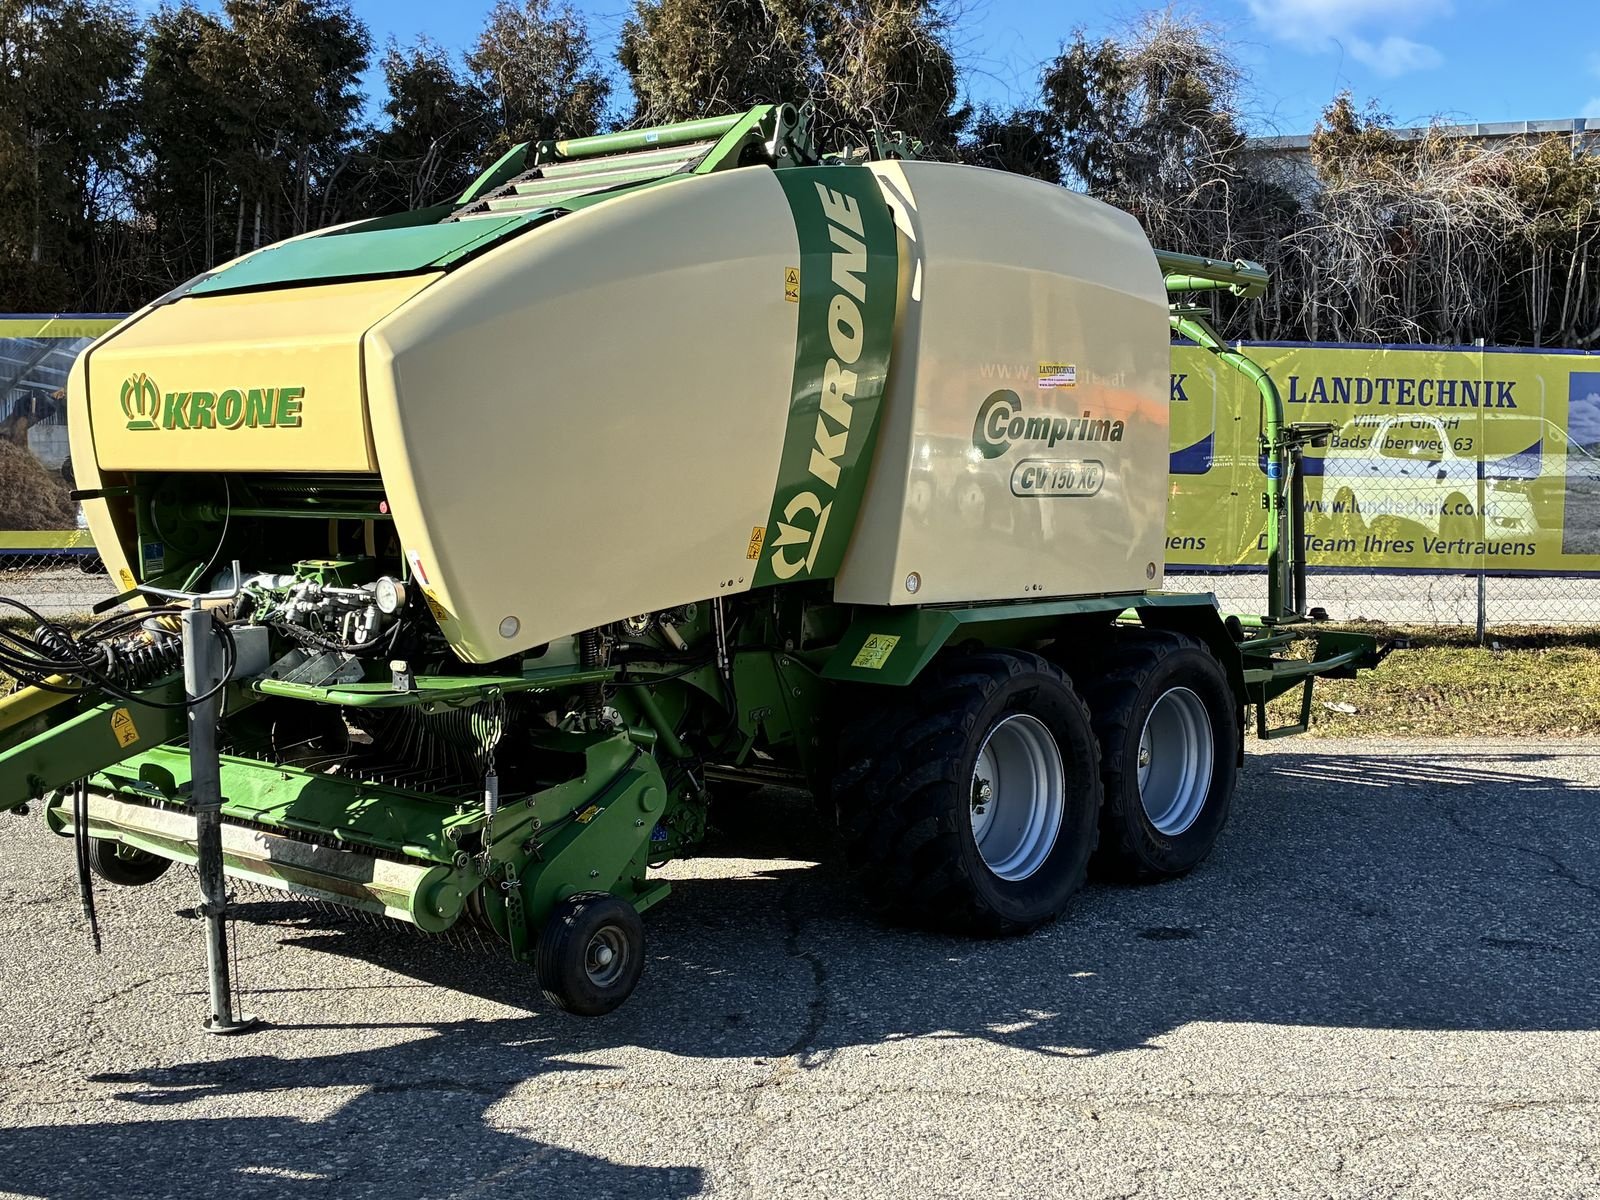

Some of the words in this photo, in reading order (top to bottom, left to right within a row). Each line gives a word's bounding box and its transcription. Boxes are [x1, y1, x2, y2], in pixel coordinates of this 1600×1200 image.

[808, 181, 868, 489] KRONE
[1039, 365, 1076, 374] LANDTECHNIK
[1288, 376, 1518, 409] LANDTECHNIK
[162, 386, 306, 430] KRONE
[1453, 437, 1474, 451] 63
[1020, 467, 1047, 489] CV
[1051, 468, 1076, 489] 150
[1077, 467, 1099, 490] XC
[1304, 534, 1356, 552] Team
[1363, 535, 1415, 553] Ihres
[1423, 537, 1537, 555] Vertrauens
